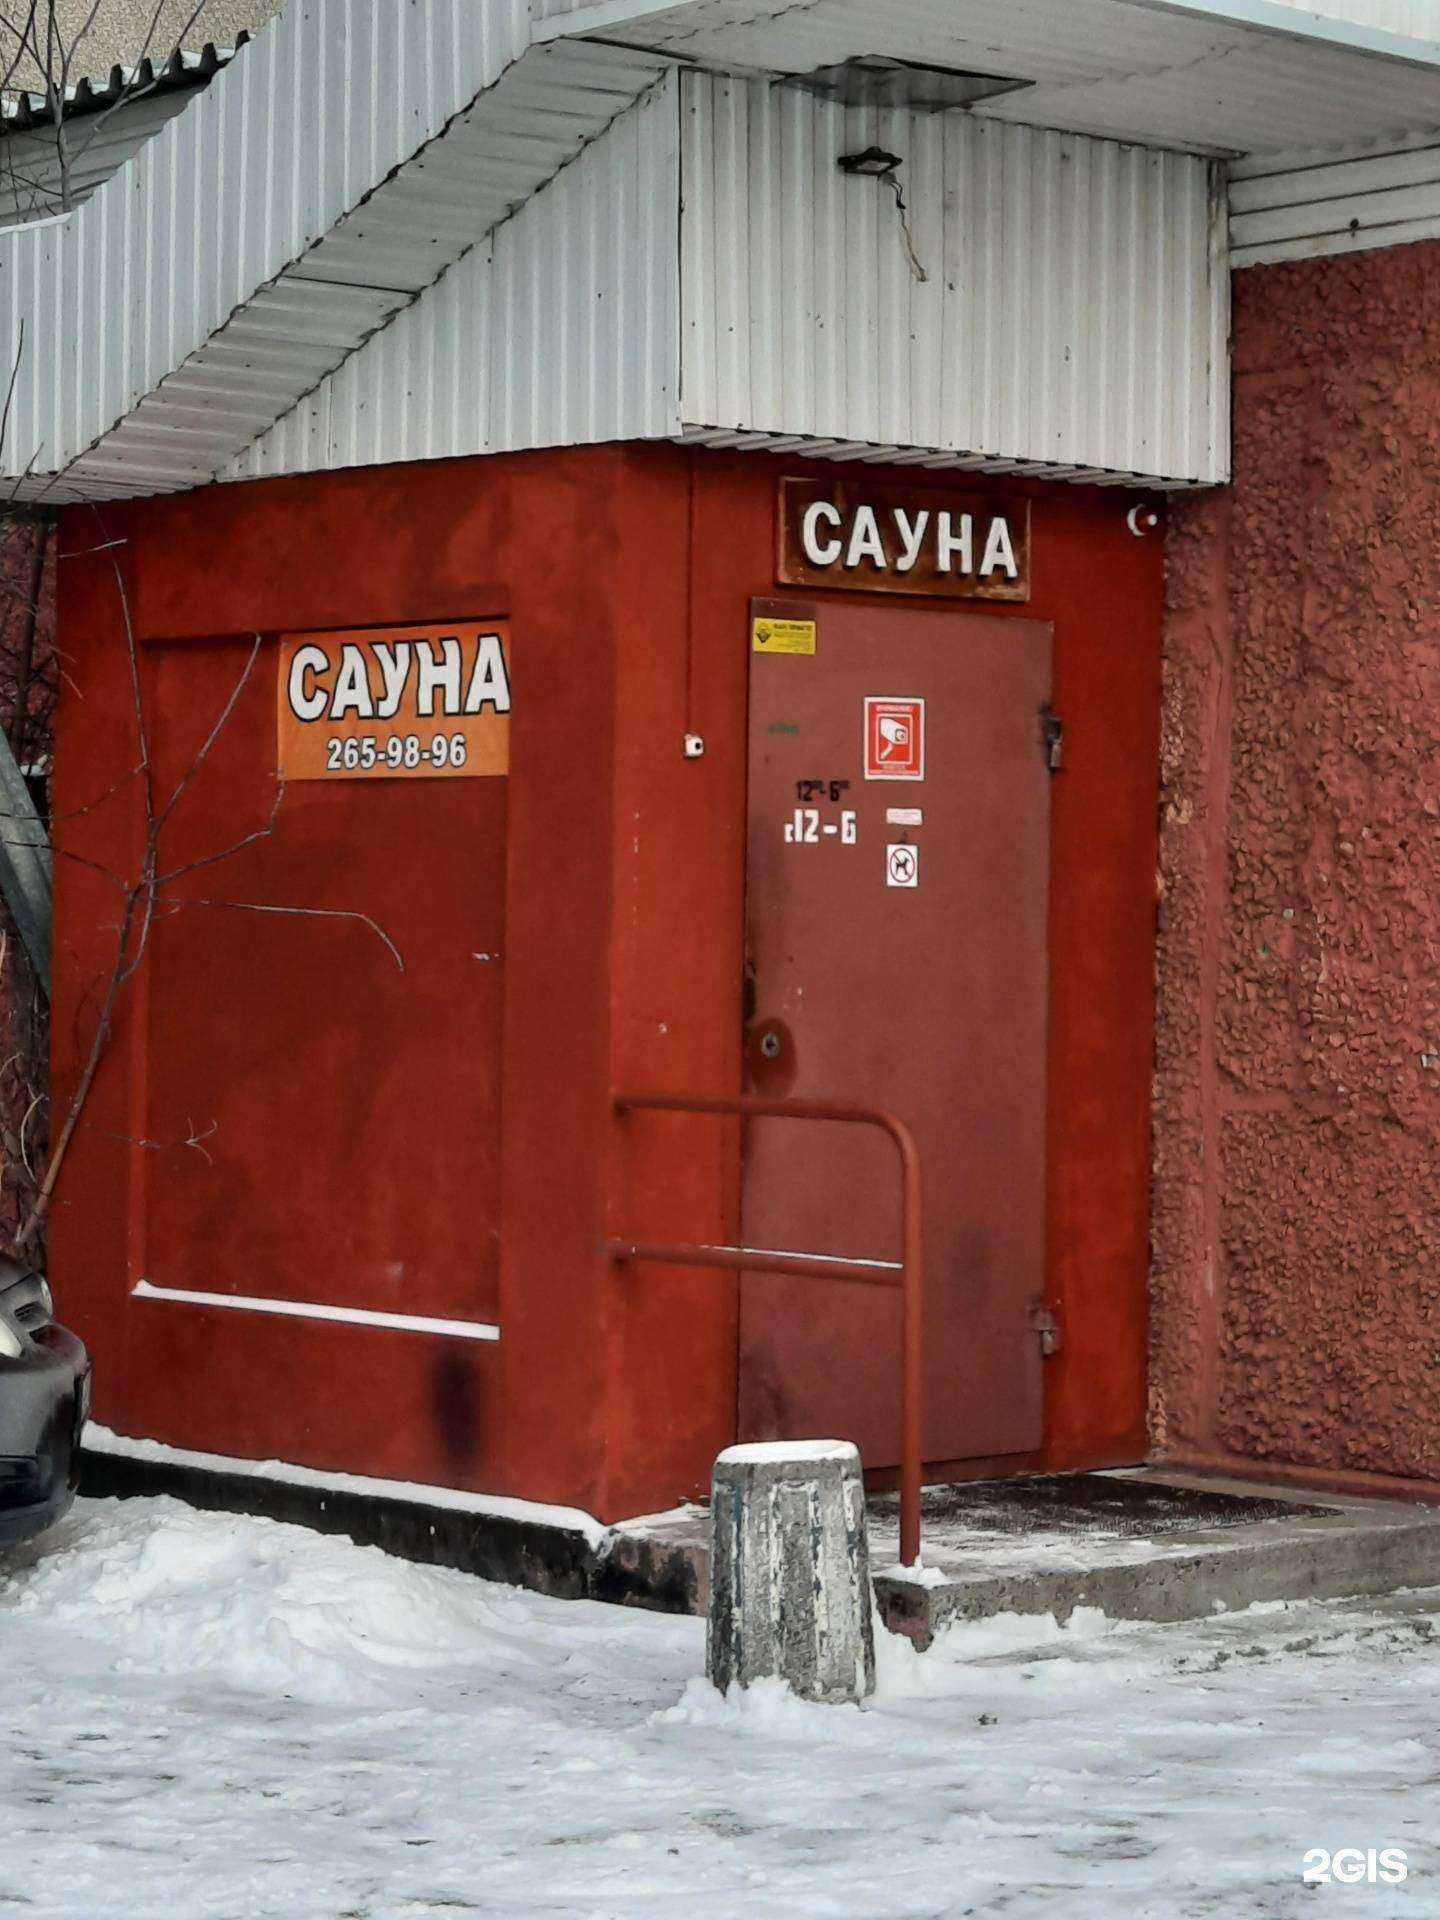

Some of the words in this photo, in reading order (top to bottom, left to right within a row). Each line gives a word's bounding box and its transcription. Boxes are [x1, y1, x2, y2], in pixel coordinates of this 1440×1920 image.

[803, 501, 1018, 578] САУНА
[288, 633, 511, 722] САУНА
[326, 732, 467, 770] 265-98-96
